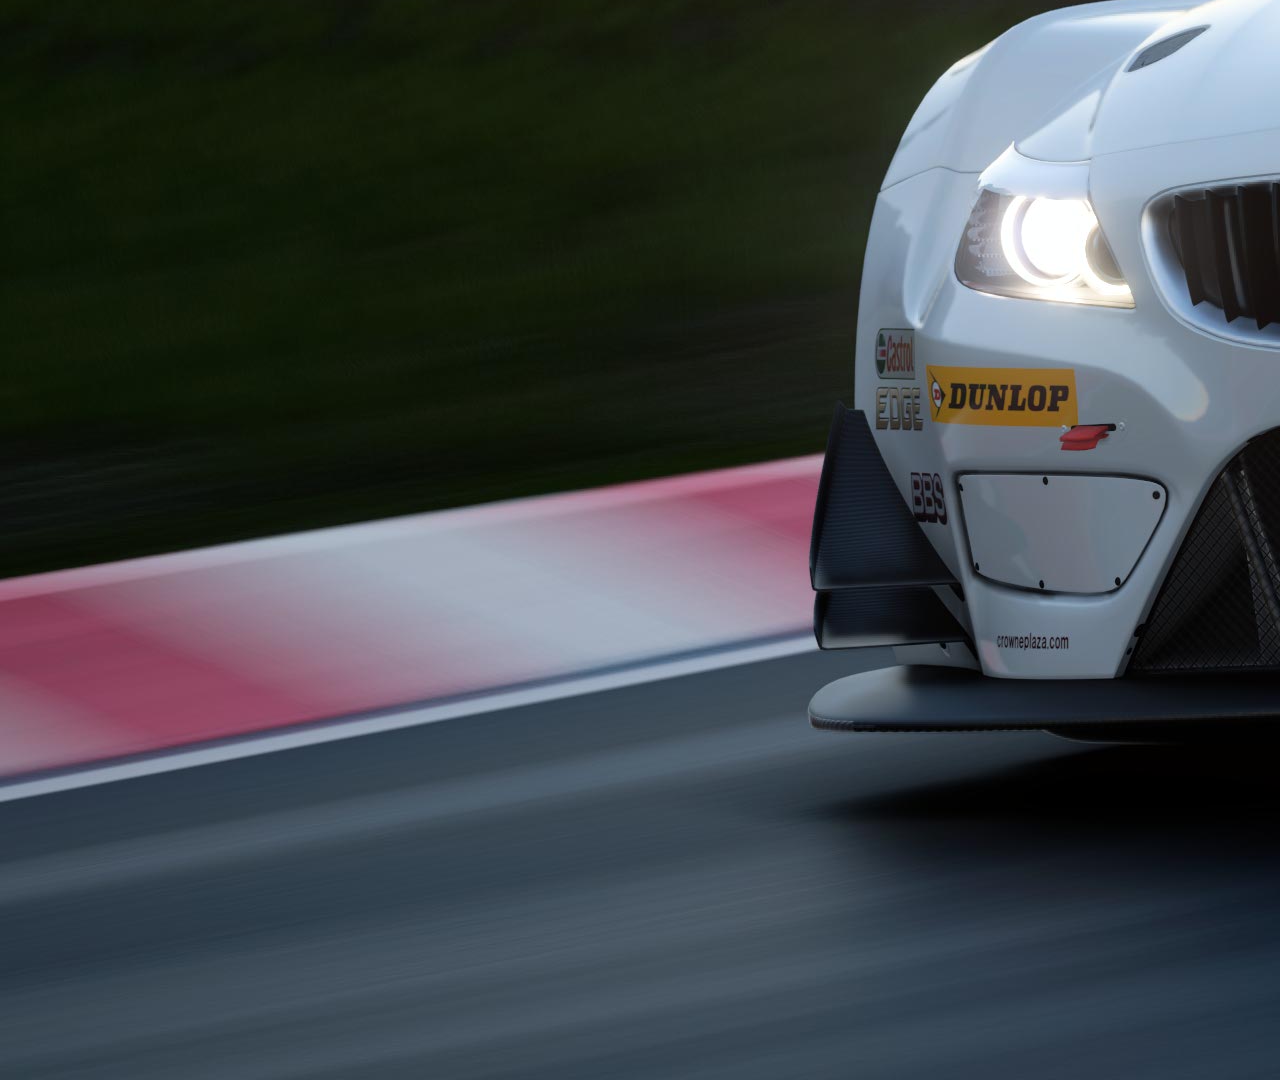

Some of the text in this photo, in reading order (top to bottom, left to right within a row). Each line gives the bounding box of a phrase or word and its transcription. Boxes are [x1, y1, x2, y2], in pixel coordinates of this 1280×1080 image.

[886, 330, 914, 373] Castrol
[875, 386, 923, 431] EDGE
[948, 382, 1069, 413] DUNLOP
[911, 472, 948, 525] BBS
[996, 632, 1069, 651] crowneplaza.com
